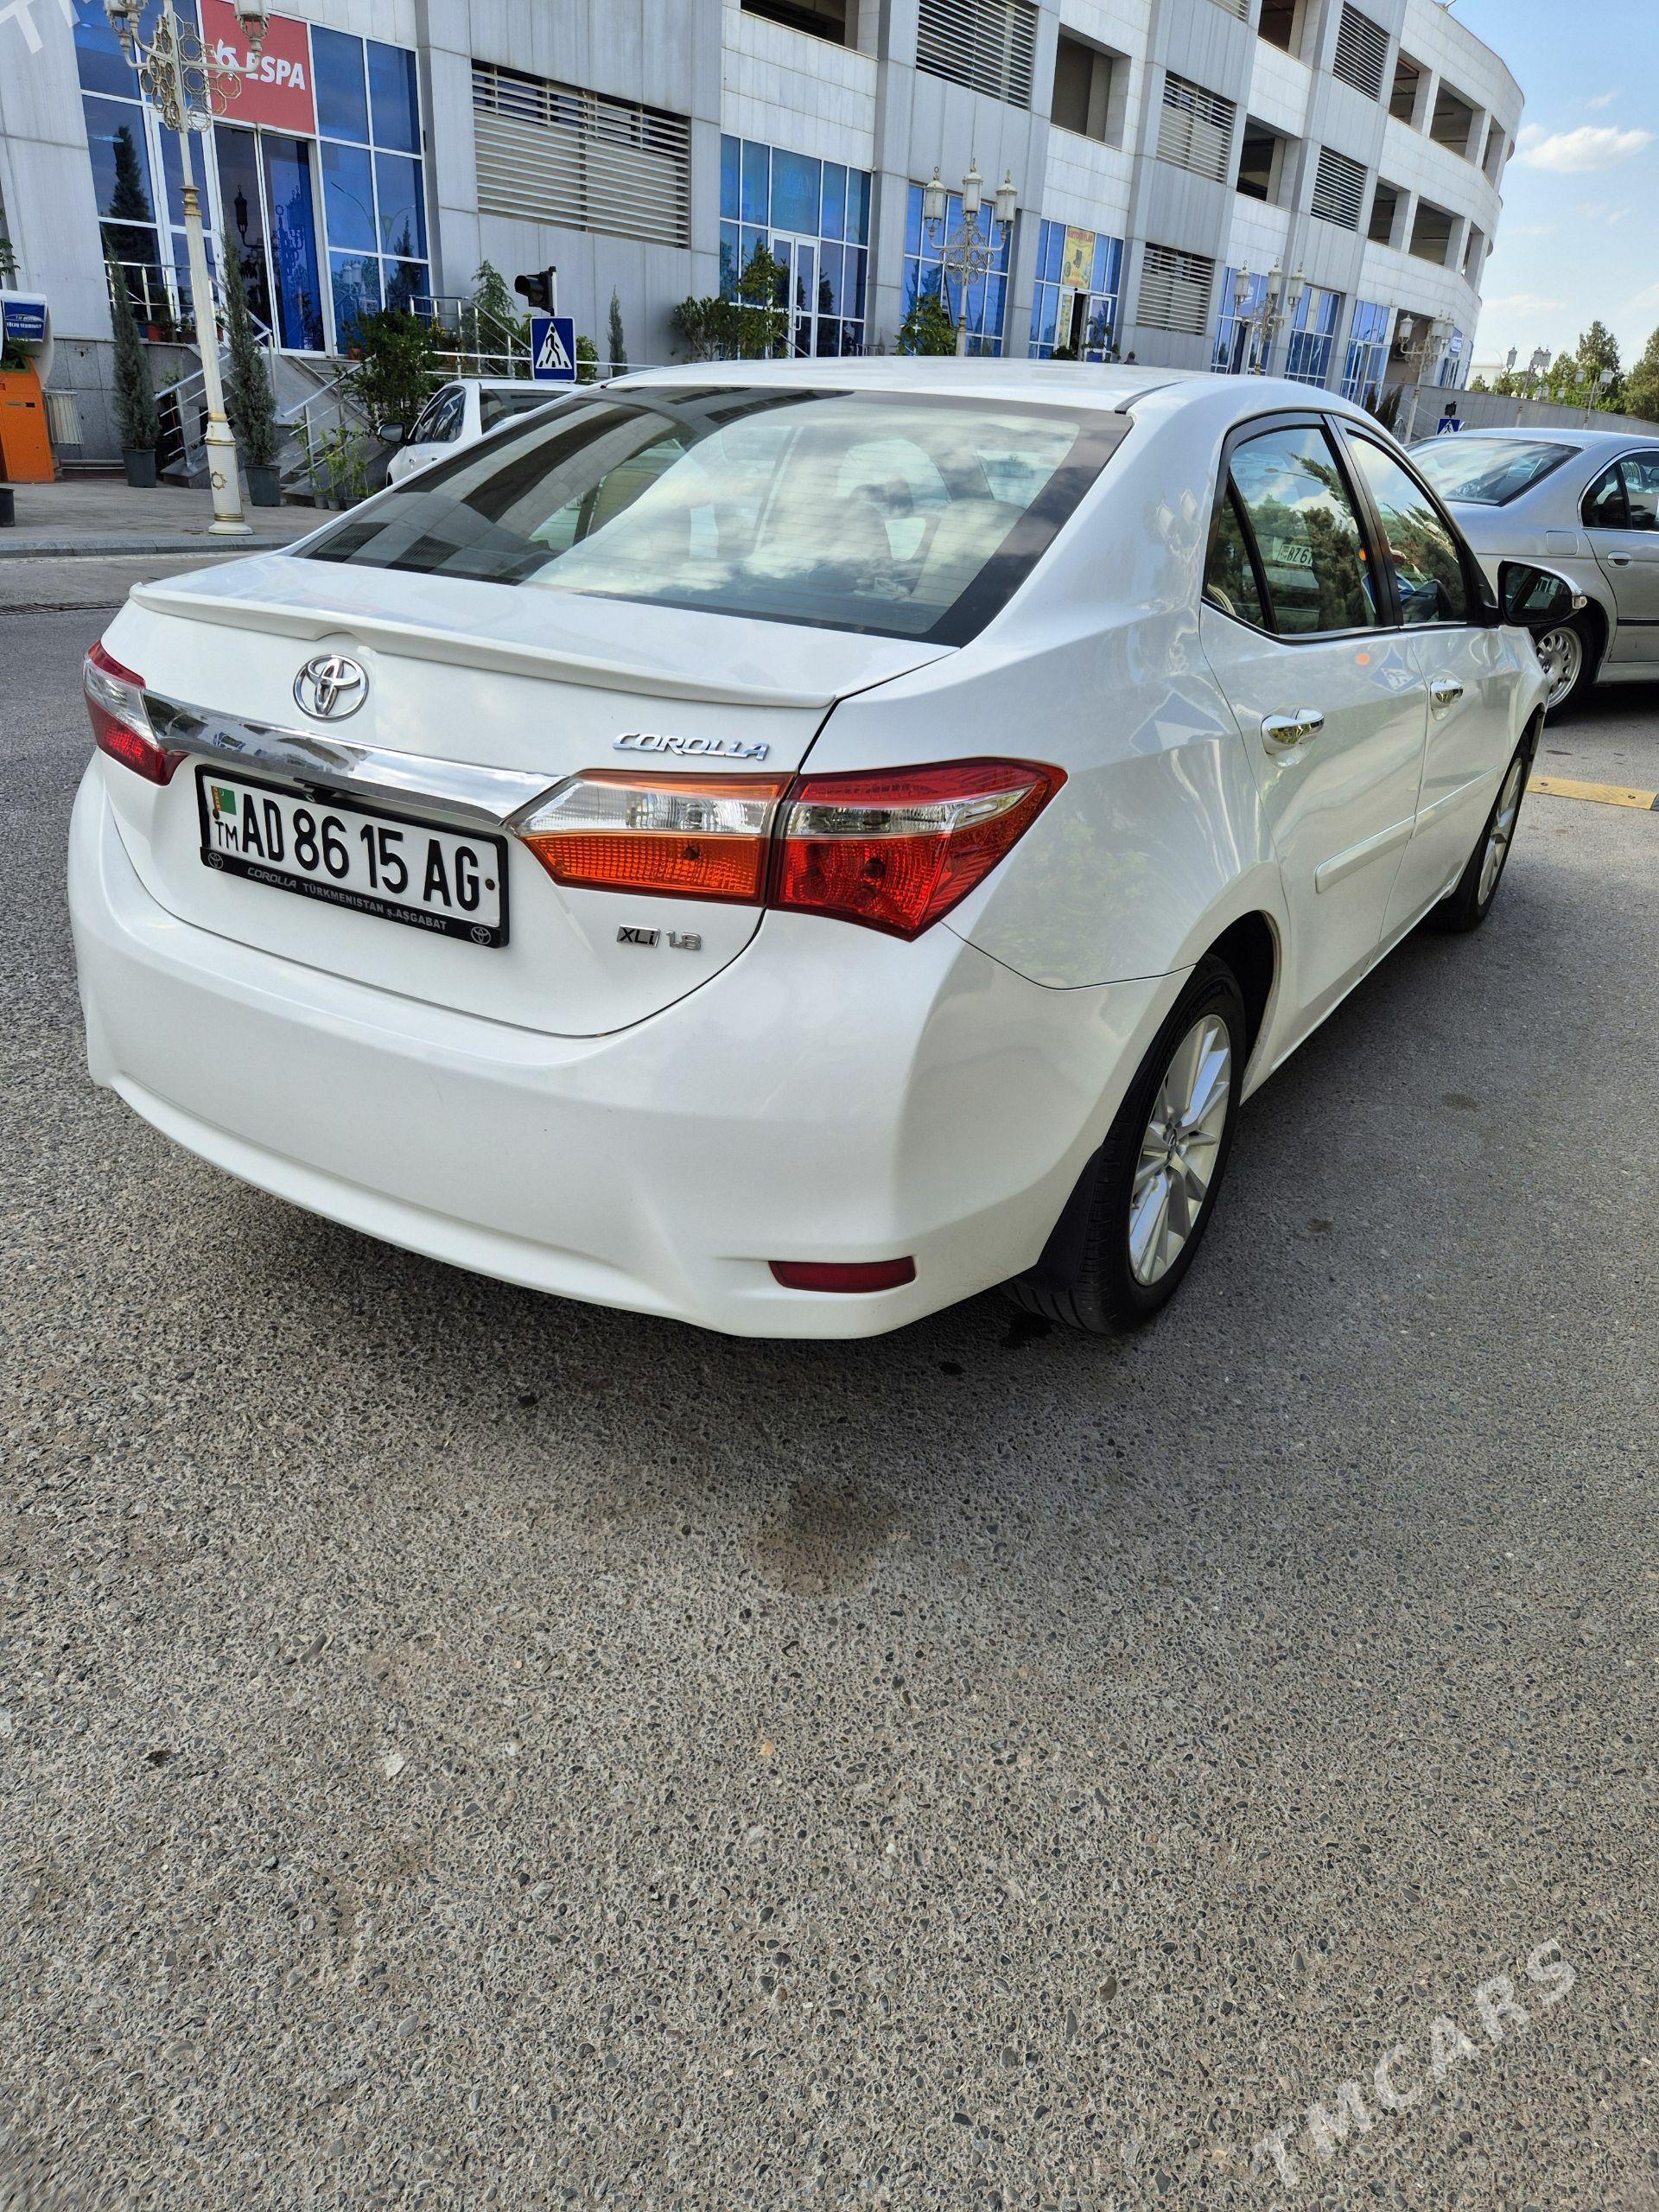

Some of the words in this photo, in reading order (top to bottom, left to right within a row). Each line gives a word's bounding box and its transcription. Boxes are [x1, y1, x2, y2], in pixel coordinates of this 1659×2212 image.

[613, 733, 771, 761] COROLLA
[215, 821, 239, 852] TM
[242, 793, 284, 862] AD
[423, 838, 480, 912] AG
[247, 867, 297, 889] COROLLA
